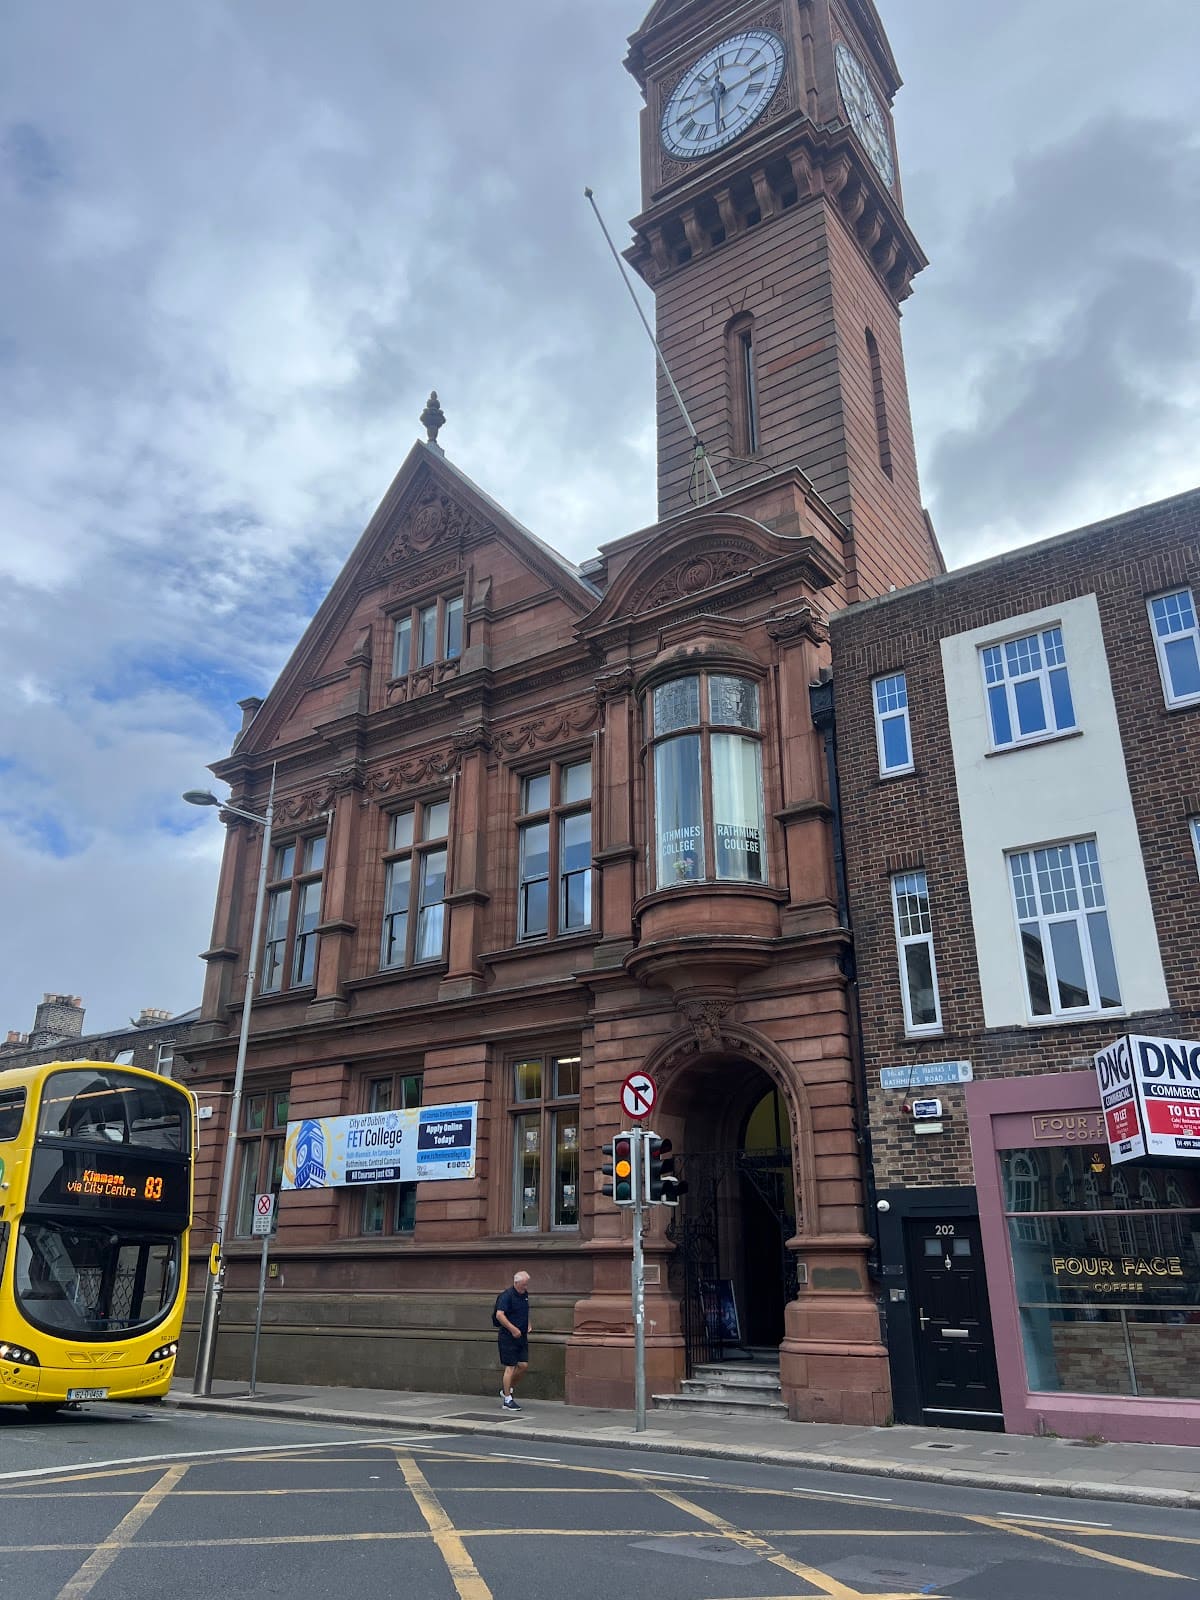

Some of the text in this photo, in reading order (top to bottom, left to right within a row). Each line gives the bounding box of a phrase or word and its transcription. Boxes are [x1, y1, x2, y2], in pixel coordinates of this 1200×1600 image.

[662, 825, 701, 843] ATHMINES
[662, 839, 695, 856] COLLEGE
[724, 838, 760, 853] COLLEGE
[961, 1066, 969, 1076] 6
[1097, 1043, 1131, 1091] DNG
[924, 1074, 944, 1083] ROAD
[1150, 1084, 1200, 1099] COMMERCI
[1167, 1104, 1200, 1118] TO LET
[349, 1115, 386, 1129] City of Dublin
[425, 1122, 463, 1135] Apply Online
[1040, 1116, 1088, 1131] FOUR
[347, 1127, 403, 1149] FET College
[434, 1134, 455, 1145] Today!
[1065, 1129, 1104, 1140] COFF
[83, 1170, 125, 1185] Kimmage
[67, 1180, 137, 1197] via City Centre
[144, 1176, 163, 1199] 83
[935, 1224, 955, 1236] 202
[1051, 1256, 1184, 1276] FOUR FACE
[1094, 1282, 1145, 1293] COFFEE
